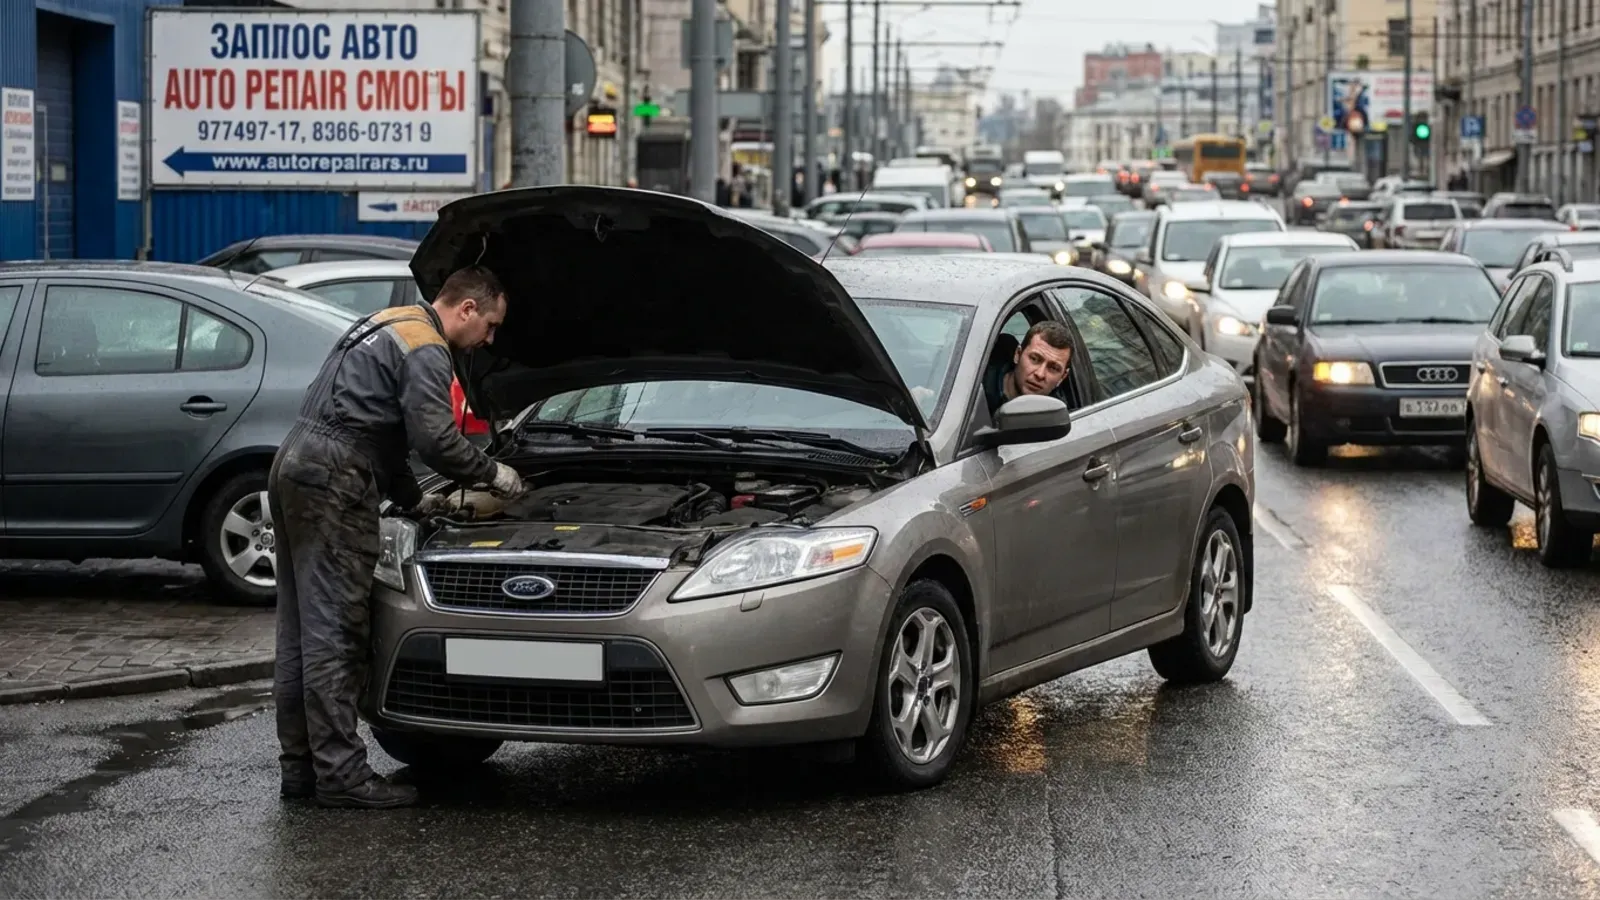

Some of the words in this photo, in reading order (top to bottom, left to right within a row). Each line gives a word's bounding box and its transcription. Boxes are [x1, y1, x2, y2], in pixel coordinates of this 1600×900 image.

[341, 24, 417, 60] АВТО
[164, 68, 235, 110] AUTO
[212, 154, 428, 172] www.autorepairars.ru
